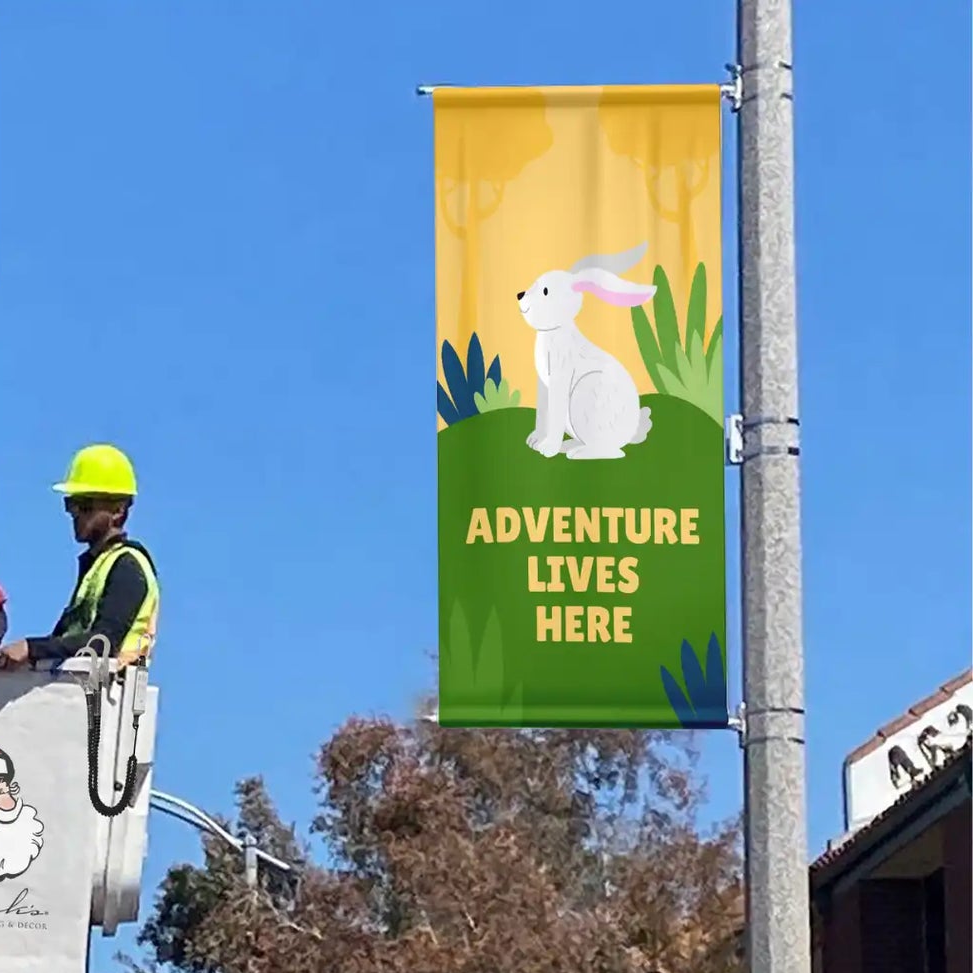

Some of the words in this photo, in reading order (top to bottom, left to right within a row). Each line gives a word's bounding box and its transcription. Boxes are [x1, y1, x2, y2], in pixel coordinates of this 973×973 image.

[465, 506, 700, 545] ADVENTURE
[527, 555, 640, 594] LIVES
[536, 605, 633, 643] HERE
